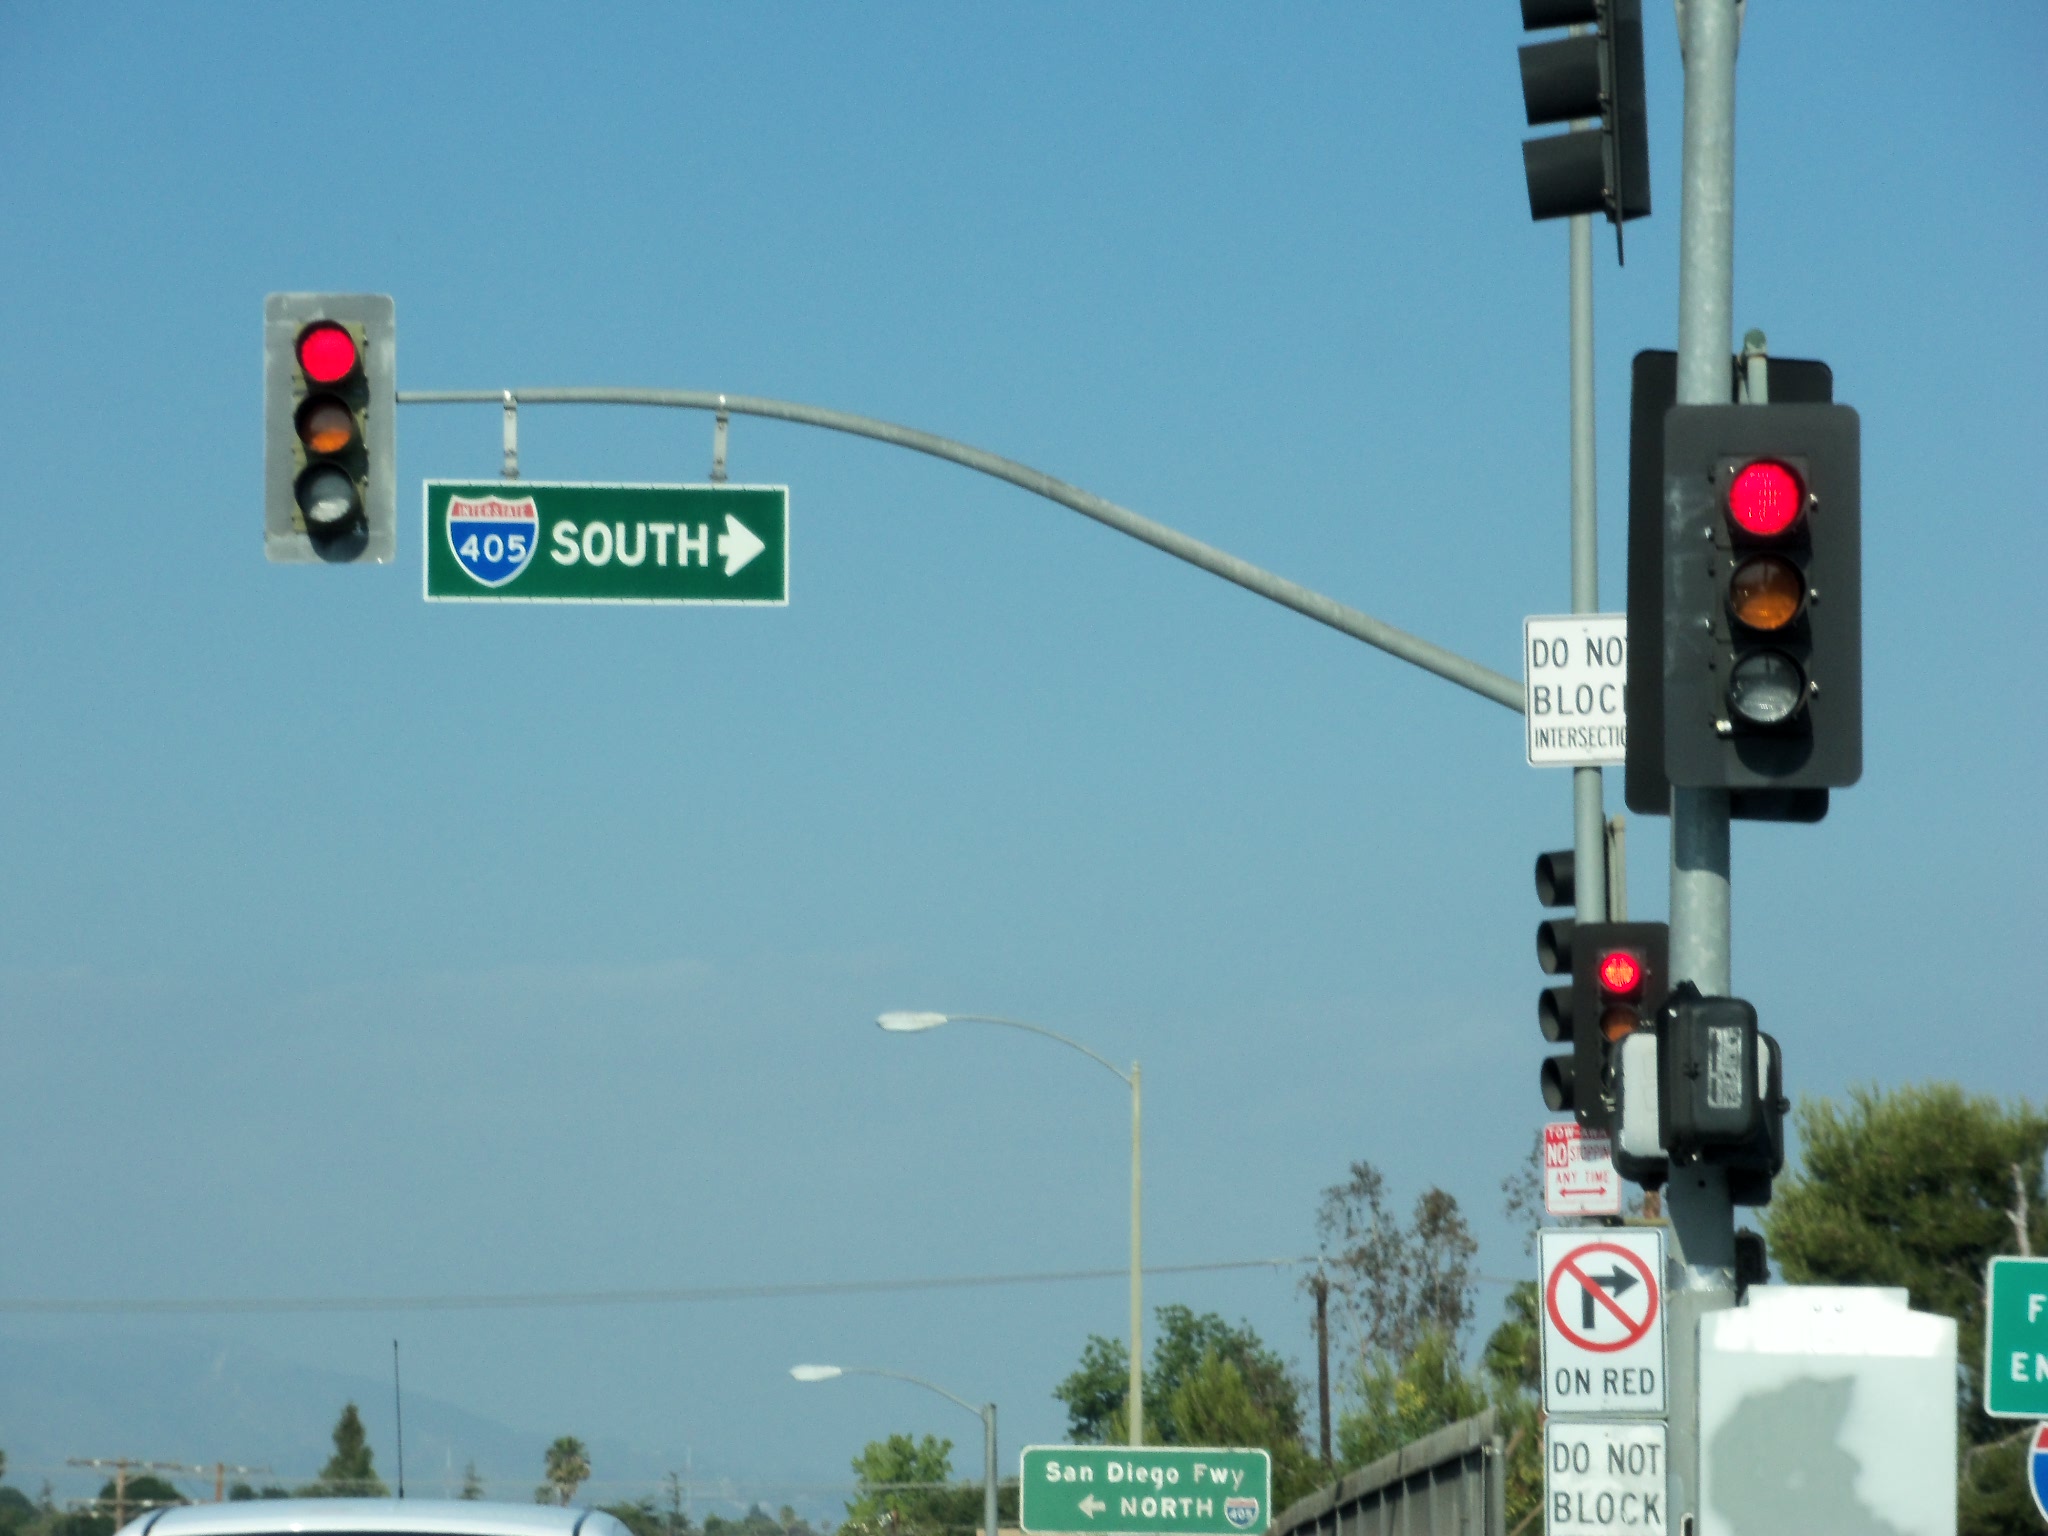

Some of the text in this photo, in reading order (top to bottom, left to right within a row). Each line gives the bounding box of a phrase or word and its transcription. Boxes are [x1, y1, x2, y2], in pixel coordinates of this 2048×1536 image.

[460, 519, 709, 568] 405 SOUTH
[1532, 636, 1627, 668] DO NO
[1534, 725, 1627, 749] INTERSECTIO
[1546, 1141, 1567, 1167] NO
[1557, 1170, 1609, 1184] ANY TIME
[1555, 1367, 1655, 1396] ON RED
[2011, 1351, 2048, 1383] EN
[1553, 1441, 1661, 1476] DO NOT
[1045, 1461, 1245, 1492] San Diego Fwy
[1120, 1496, 1213, 1519] NORTH
[1554, 1491, 1661, 1526] BLOCK
